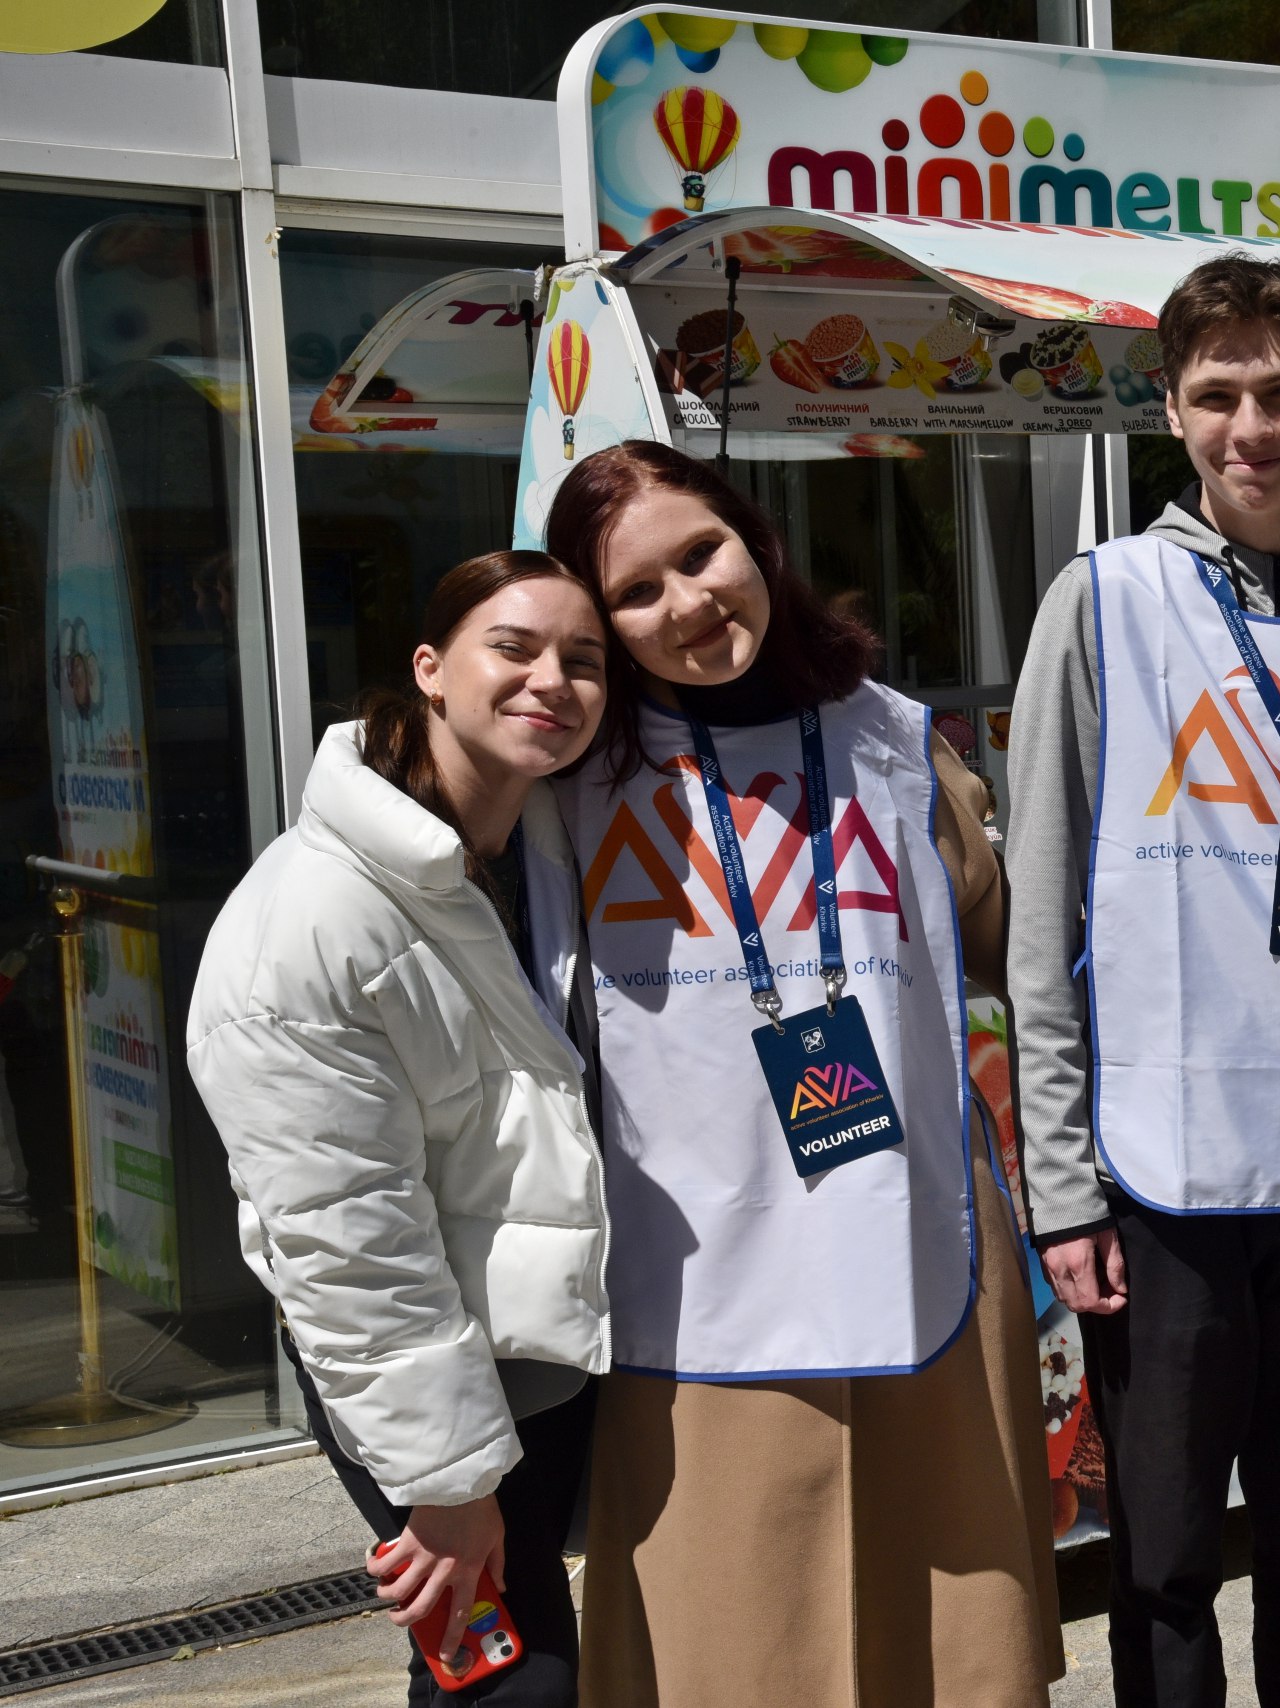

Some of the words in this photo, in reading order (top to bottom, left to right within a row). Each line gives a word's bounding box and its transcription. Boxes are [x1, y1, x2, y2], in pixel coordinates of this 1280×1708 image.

[678, 401, 760, 413] ШОКОЛДНИЙ
[787, 416, 851, 427] STRAWBERRY
[795, 403, 870, 414] ПОЛУНИЧНИЙ
[927, 404, 985, 415] ВАНІЛЬНИЙ
[1043, 405, 1103, 416] ВЕРШКОВИЙ
[869, 417, 918, 428] BARBERRY
[923, 418, 947, 429] WITH
[949, 418, 1014, 430] MARSHMELLOW
[1022, 422, 1054, 432] CREAMY
[1121, 419, 1159, 432] BUBBLE
[1219, 602, 1243, 647] association
[1243, 653, 1262, 684] Kharkiv
[1231, 608, 1246, 634] Active
[1243, 631, 1264, 670] volunteer
[699, 753, 718, 787] AVA
[583, 755, 909, 943] AVA
[710, 804, 727, 854] association
[725, 864, 738, 898] Kharkiv
[722, 814, 734, 842] Active
[728, 842, 745, 885] volunteer
[1135, 842, 1194, 860] active
[818, 905, 828, 934] Kharkiv
[828, 902, 838, 939] Volunteer
[622, 965, 717, 987] volunteer
[725, 958, 843, 983] asociati
[854, 956, 876, 976] of
[789, 1062, 879, 1121] AVA
[806, 1114, 830, 1126] volunteer
[830, 1103, 859, 1117] association
[798, 1115, 892, 1158] VOLUNTEER
